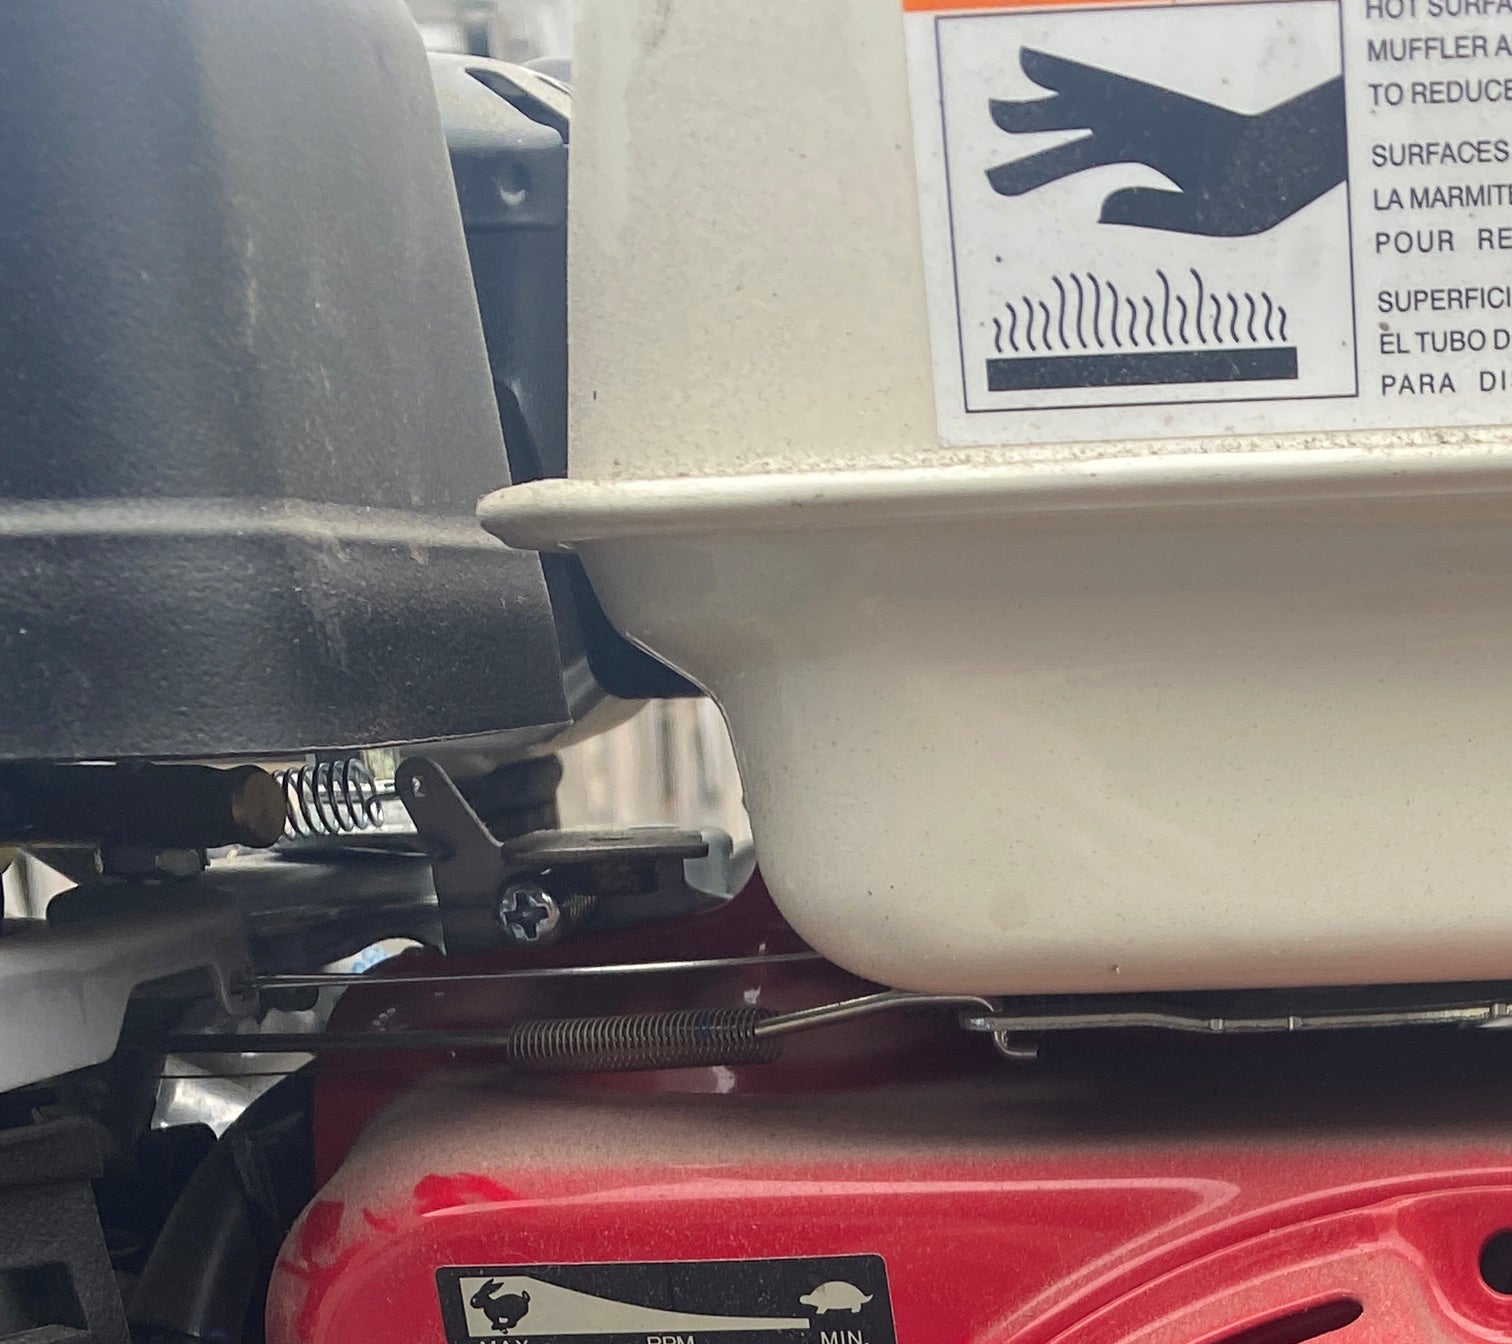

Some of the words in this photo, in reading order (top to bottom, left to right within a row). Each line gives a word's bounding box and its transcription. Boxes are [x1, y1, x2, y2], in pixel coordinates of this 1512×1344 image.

[1367, 35, 1488, 61] MUFFLER
[1369, 82, 1403, 106] TO
[1372, 139, 1509, 167] SURFACES
[1373, 188, 1404, 210] LA
[1375, 229, 1454, 253] POUR
[1379, 331, 1409, 354] EL
[1414, 329, 1485, 352] TUBO
[1381, 372, 1455, 395] PARA
